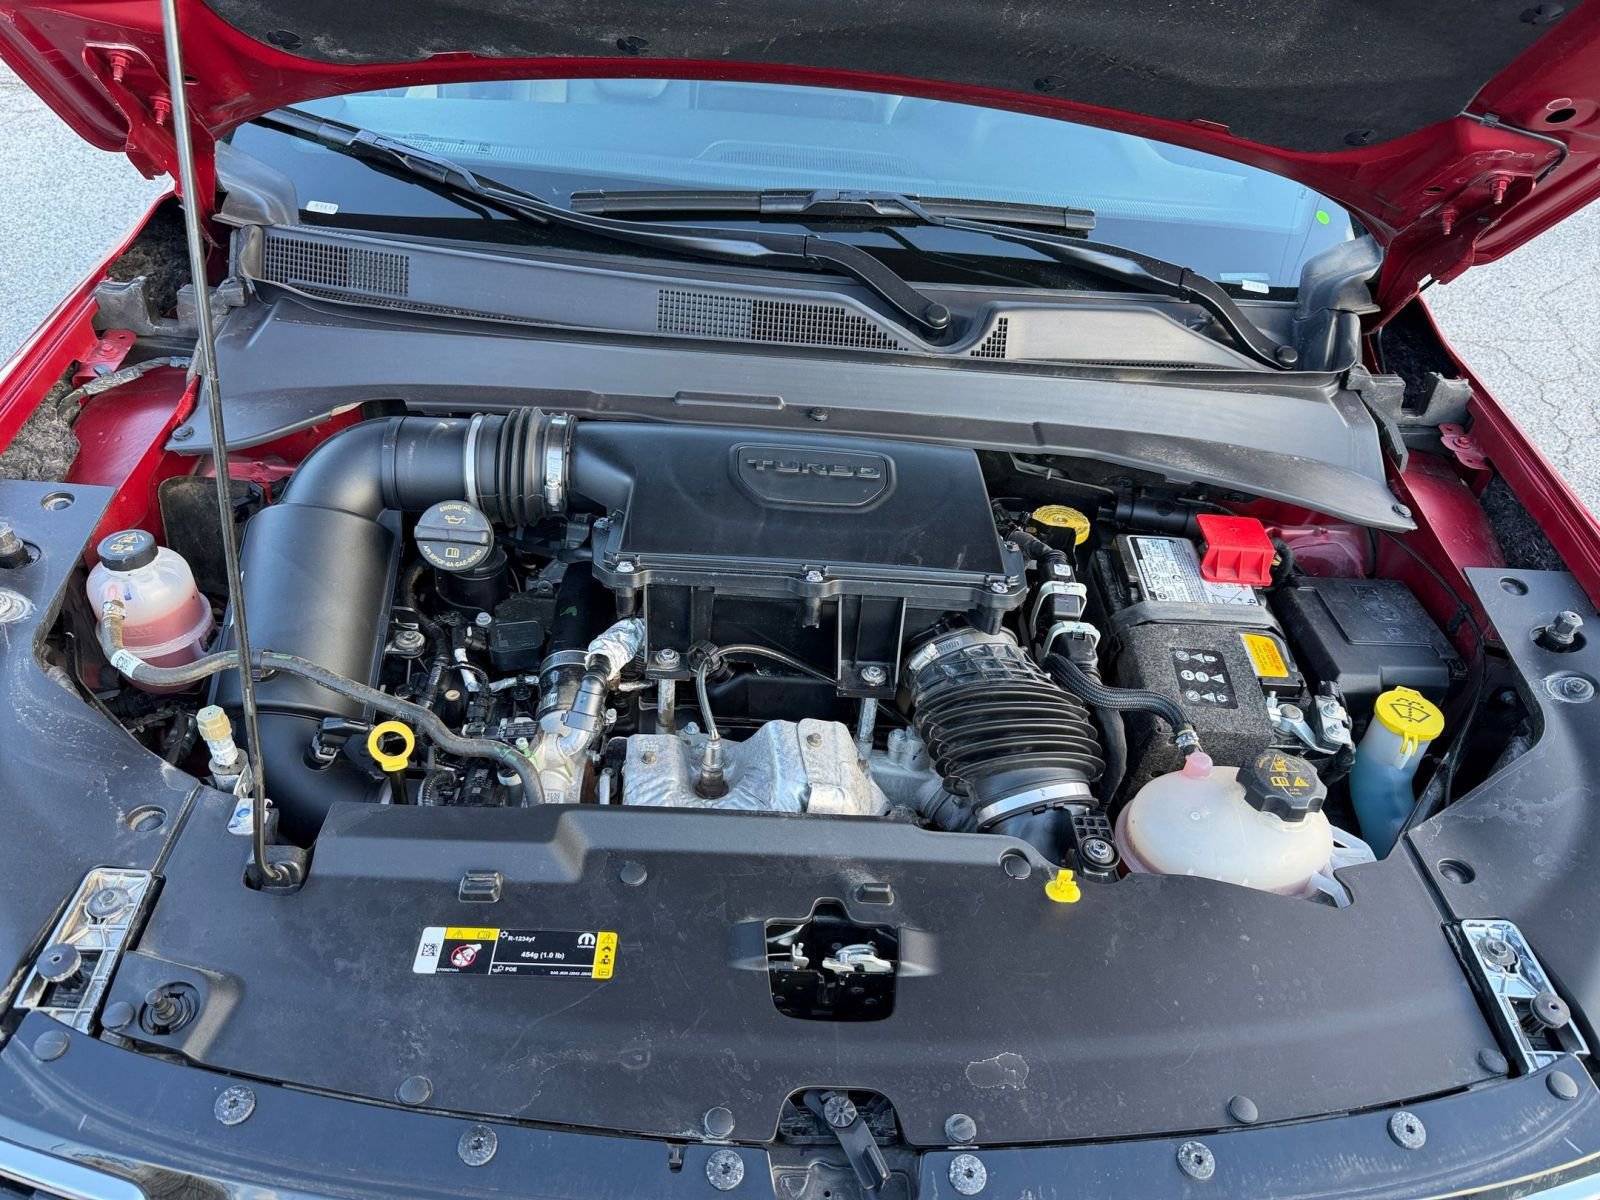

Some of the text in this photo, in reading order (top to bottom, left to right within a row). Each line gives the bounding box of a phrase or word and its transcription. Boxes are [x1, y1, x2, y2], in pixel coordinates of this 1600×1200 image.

[746, 457, 881, 479] TURBO
[440, 504, 472, 515] ENGINE OIL
[423, 545, 431, 555] API
[521, 951, 539, 960] 454g
[555, 952, 565, 960] lb)
